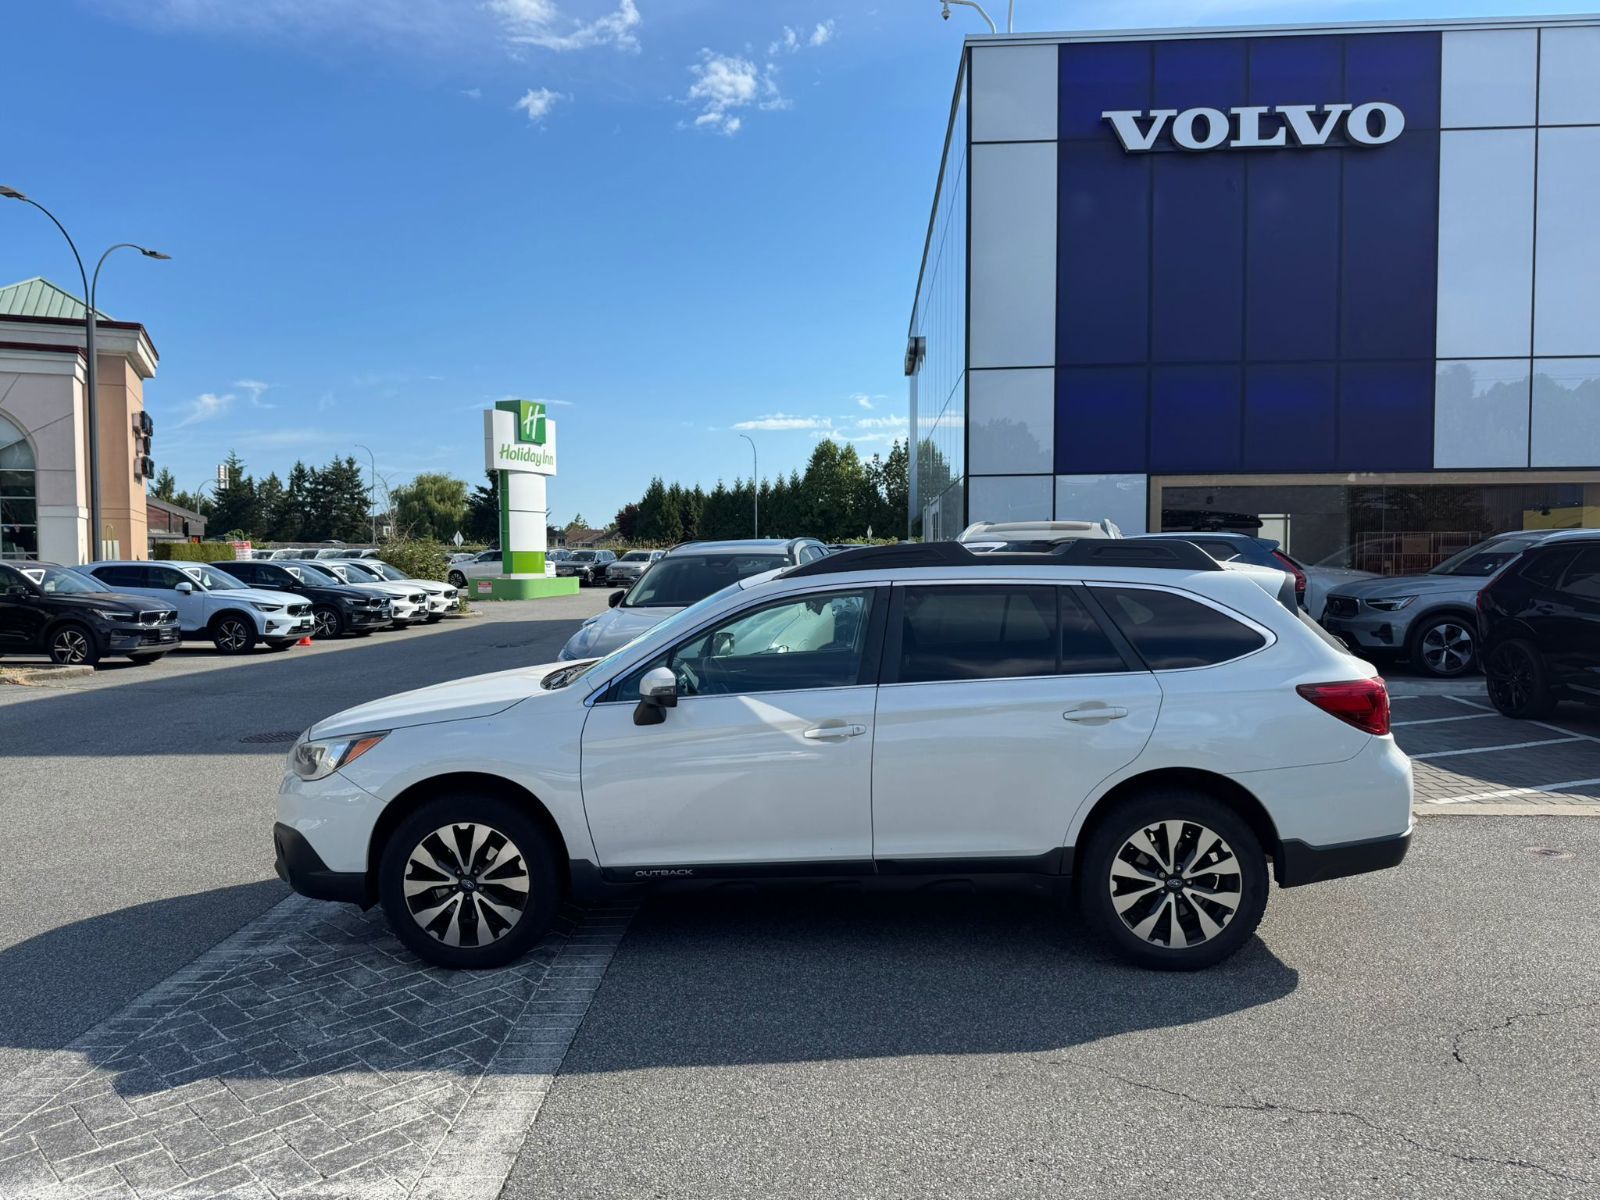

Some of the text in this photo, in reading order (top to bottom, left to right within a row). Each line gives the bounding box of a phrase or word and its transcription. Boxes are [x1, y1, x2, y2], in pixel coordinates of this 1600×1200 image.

[1101, 101, 1406, 151] VOLVO
[499, 443, 554, 467] Holiday Inn
[634, 869, 694, 877] OUTBACK
